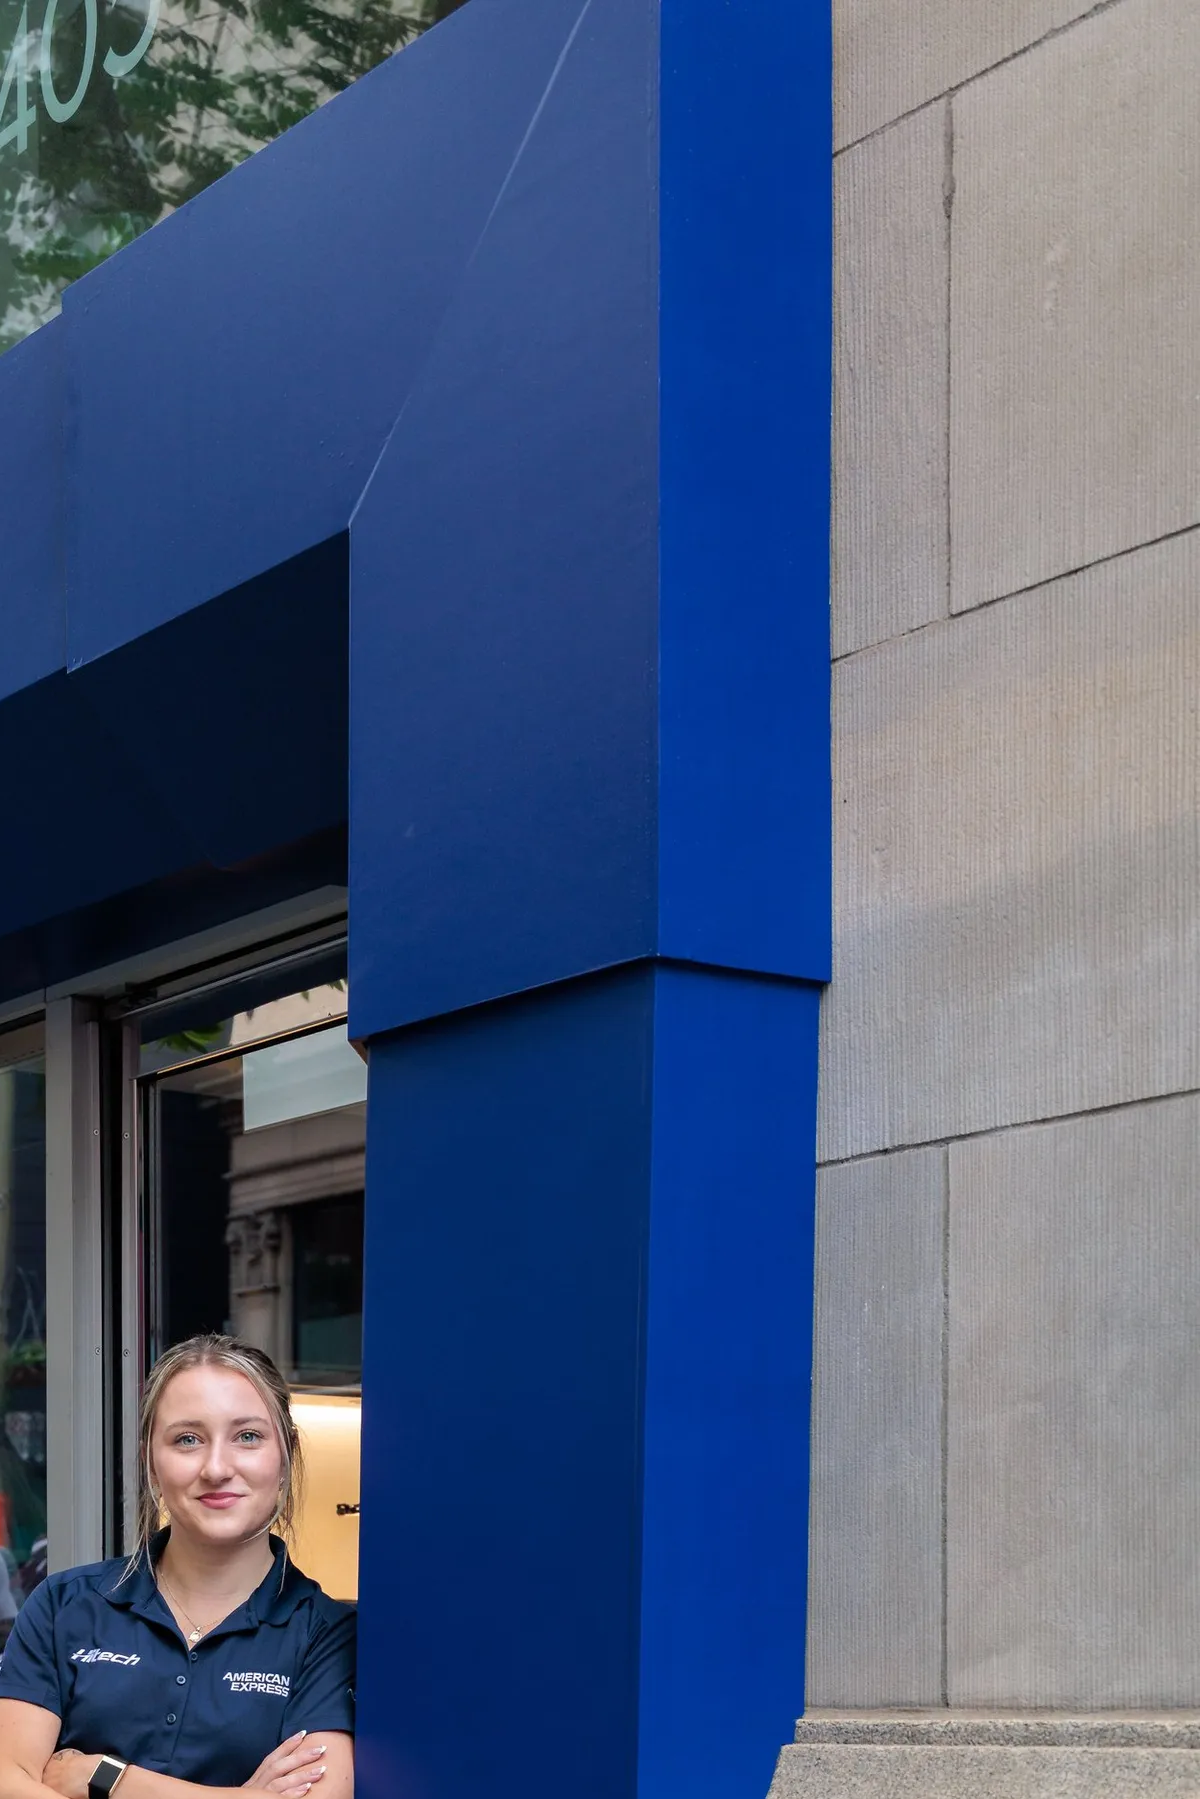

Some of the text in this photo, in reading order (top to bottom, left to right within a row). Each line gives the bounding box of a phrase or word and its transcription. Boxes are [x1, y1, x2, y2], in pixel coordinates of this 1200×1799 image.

[70, 1648, 141, 1666] Hitech
[222, 1671, 291, 1687] AMERICAN
[230, 1681, 290, 1698] EXPRESS
